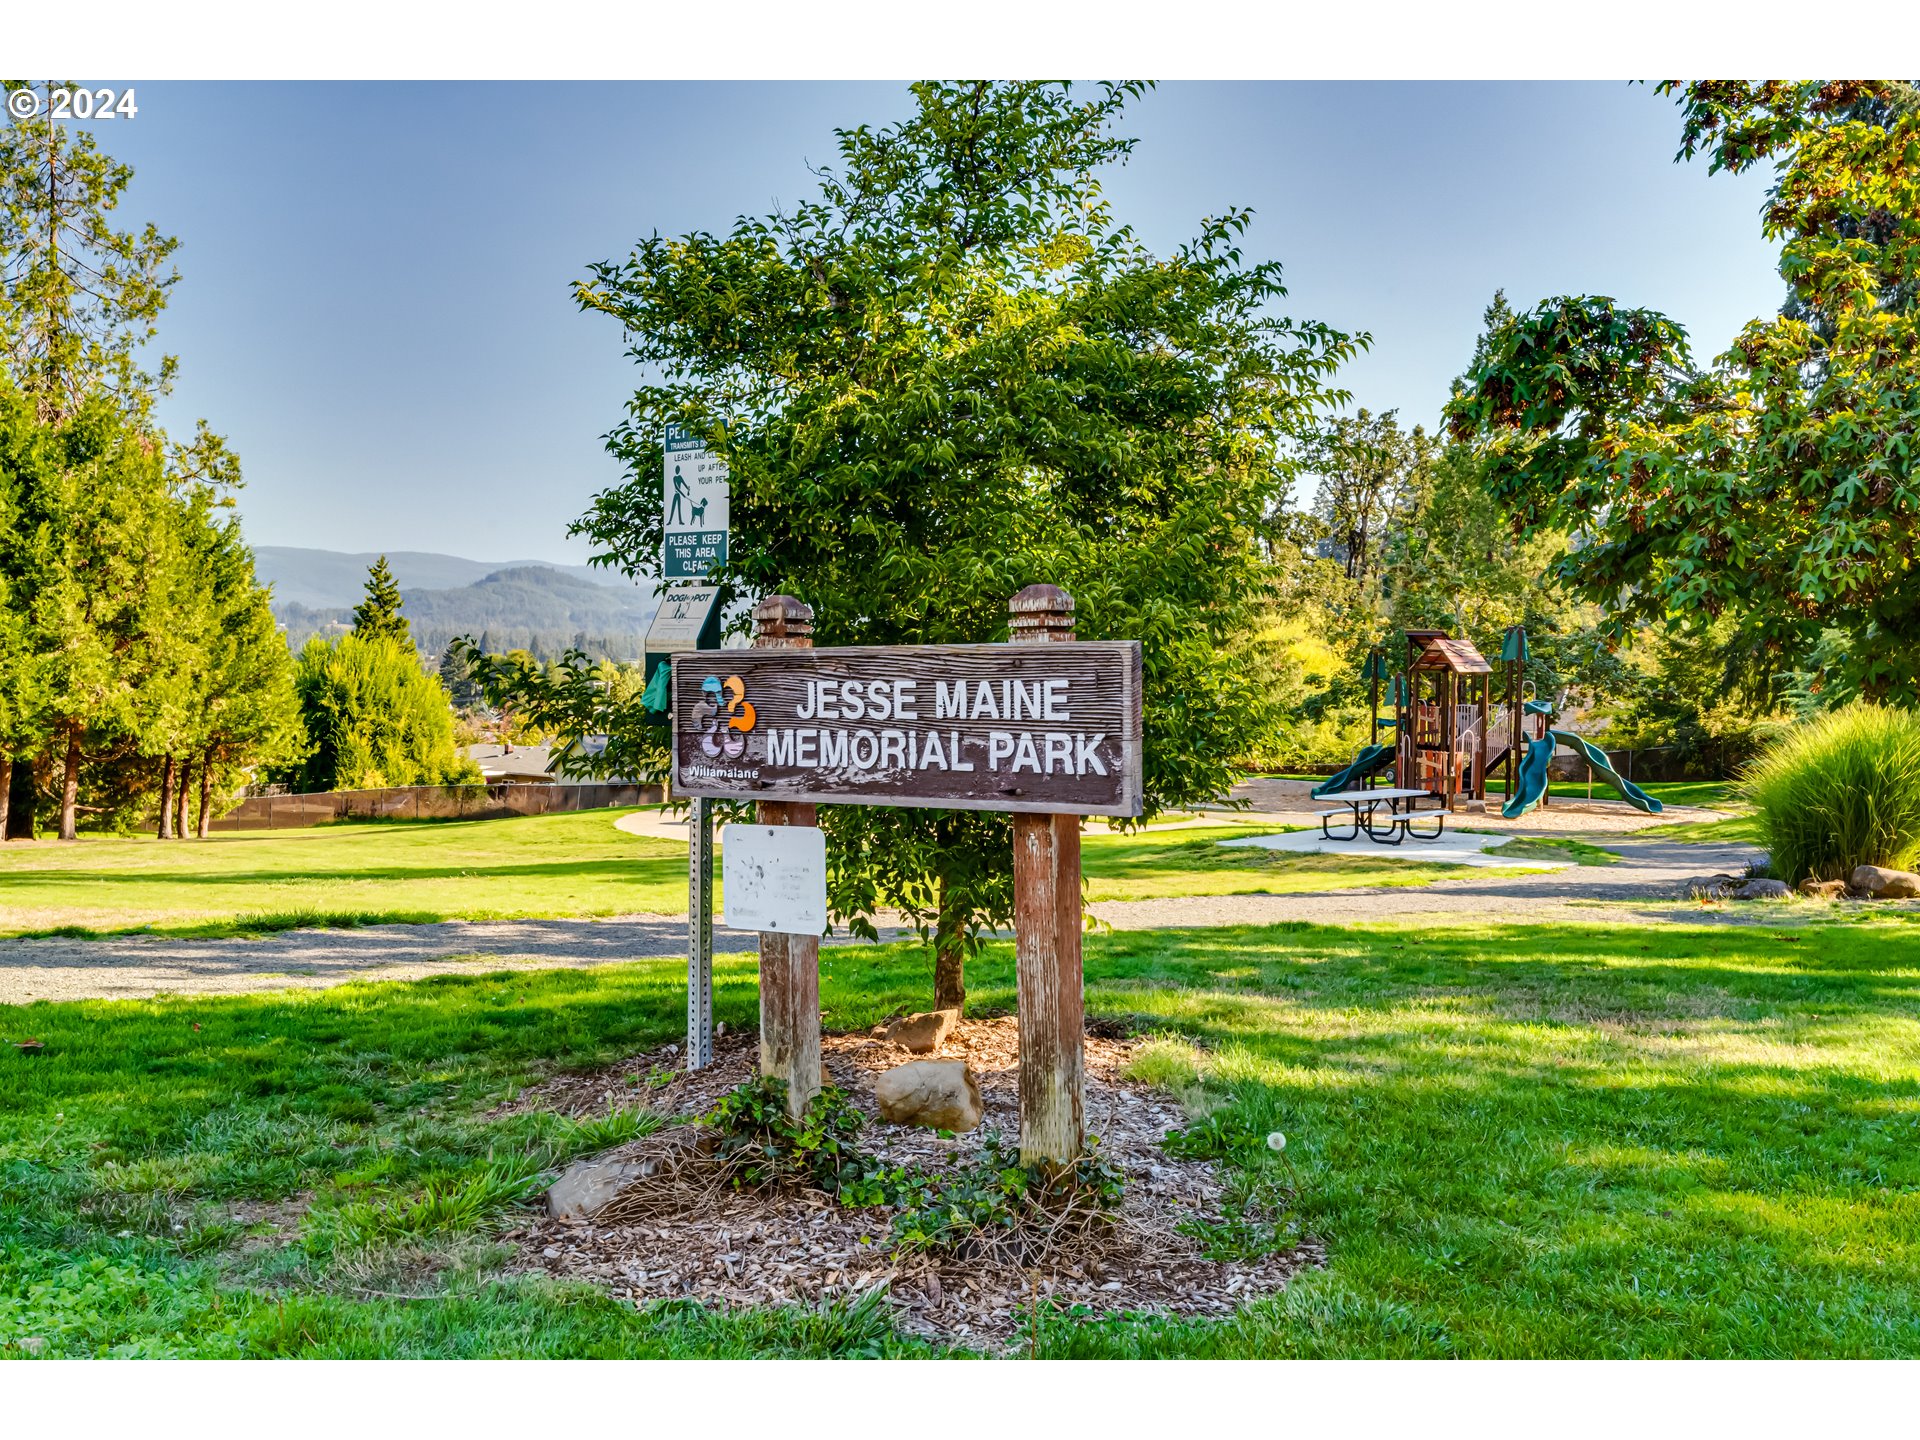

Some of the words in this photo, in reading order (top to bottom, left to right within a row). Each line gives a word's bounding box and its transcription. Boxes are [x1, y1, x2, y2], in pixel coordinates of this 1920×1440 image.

[670, 441, 698, 450] TRANSMITS
[674, 454, 692, 462] LEASH
[694, 452, 705, 460] AND
[698, 464, 705, 472] UP
[698, 477, 713, 485] YOUR
[716, 475, 726, 484] PET
[669, 535, 698, 546] PLEASE
[702, 534, 722, 544] KEEP
[674, 548, 692, 558] THIS
[695, 547, 716, 558] AREA
[682, 560, 708, 570] CLEAN
[796, 680, 917, 720] JESSE
[935, 679, 1070, 721] MAINE
[766, 728, 974, 772] MEMORIAL
[988, 732, 1107, 776] PARK
[689, 765, 759, 779] Willamalane
